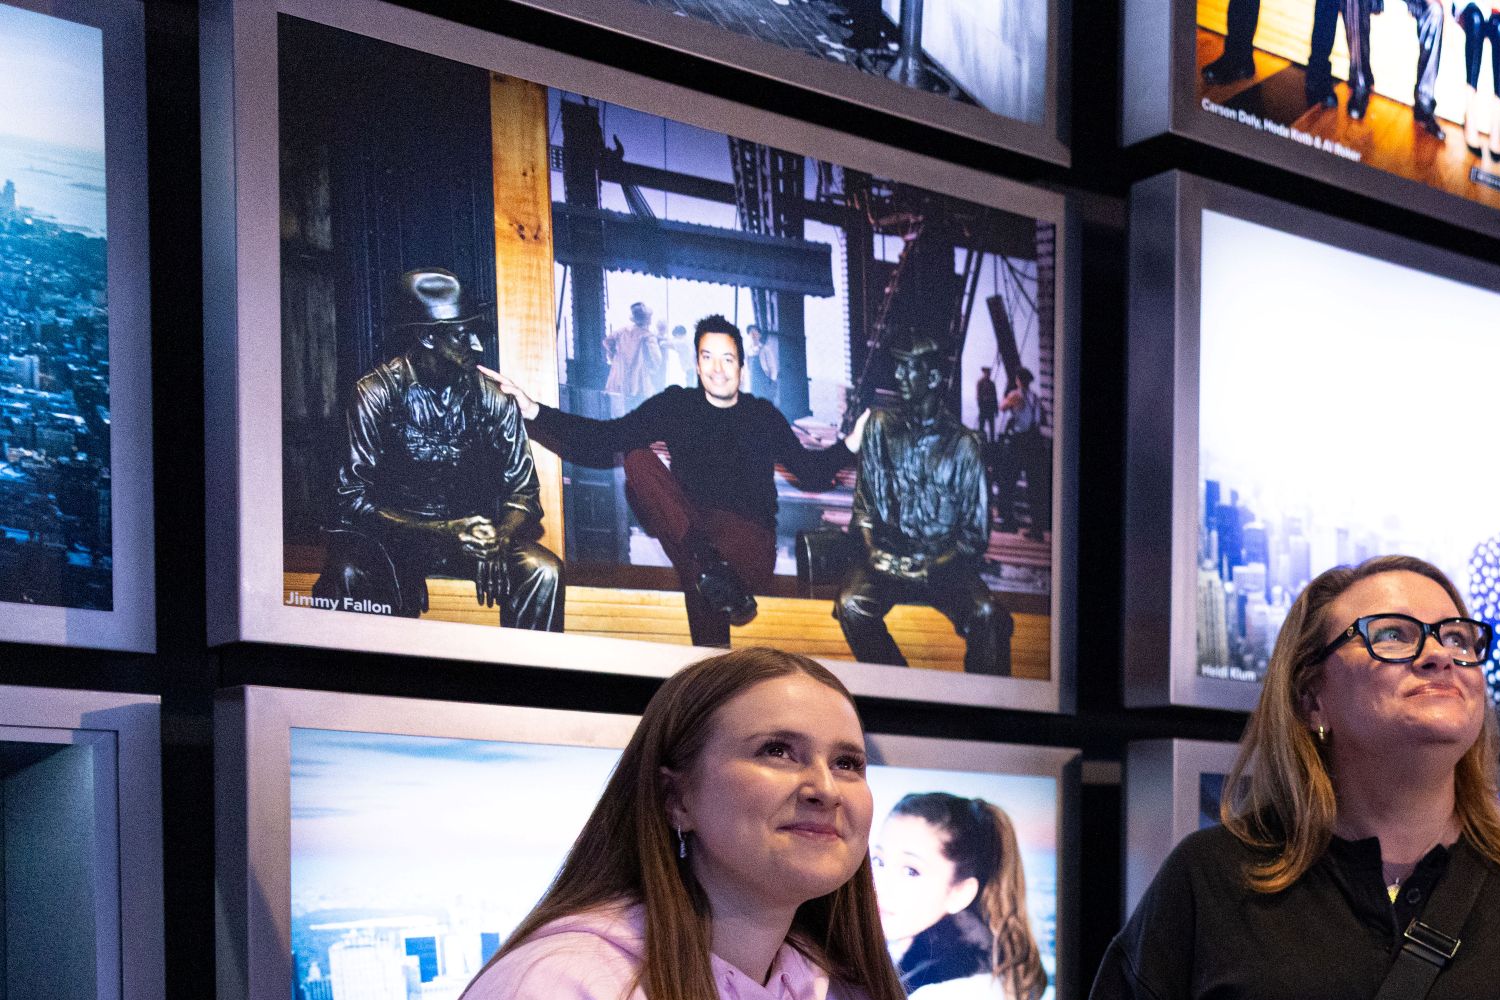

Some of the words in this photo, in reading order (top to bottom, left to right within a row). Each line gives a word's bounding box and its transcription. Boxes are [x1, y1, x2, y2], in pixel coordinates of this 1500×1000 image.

[1201, 97, 1238, 120] Carson
[1313, 135, 1322, 149] &
[285, 591, 339, 611] Jimmy
[343, 597, 392, 614] Fallon
